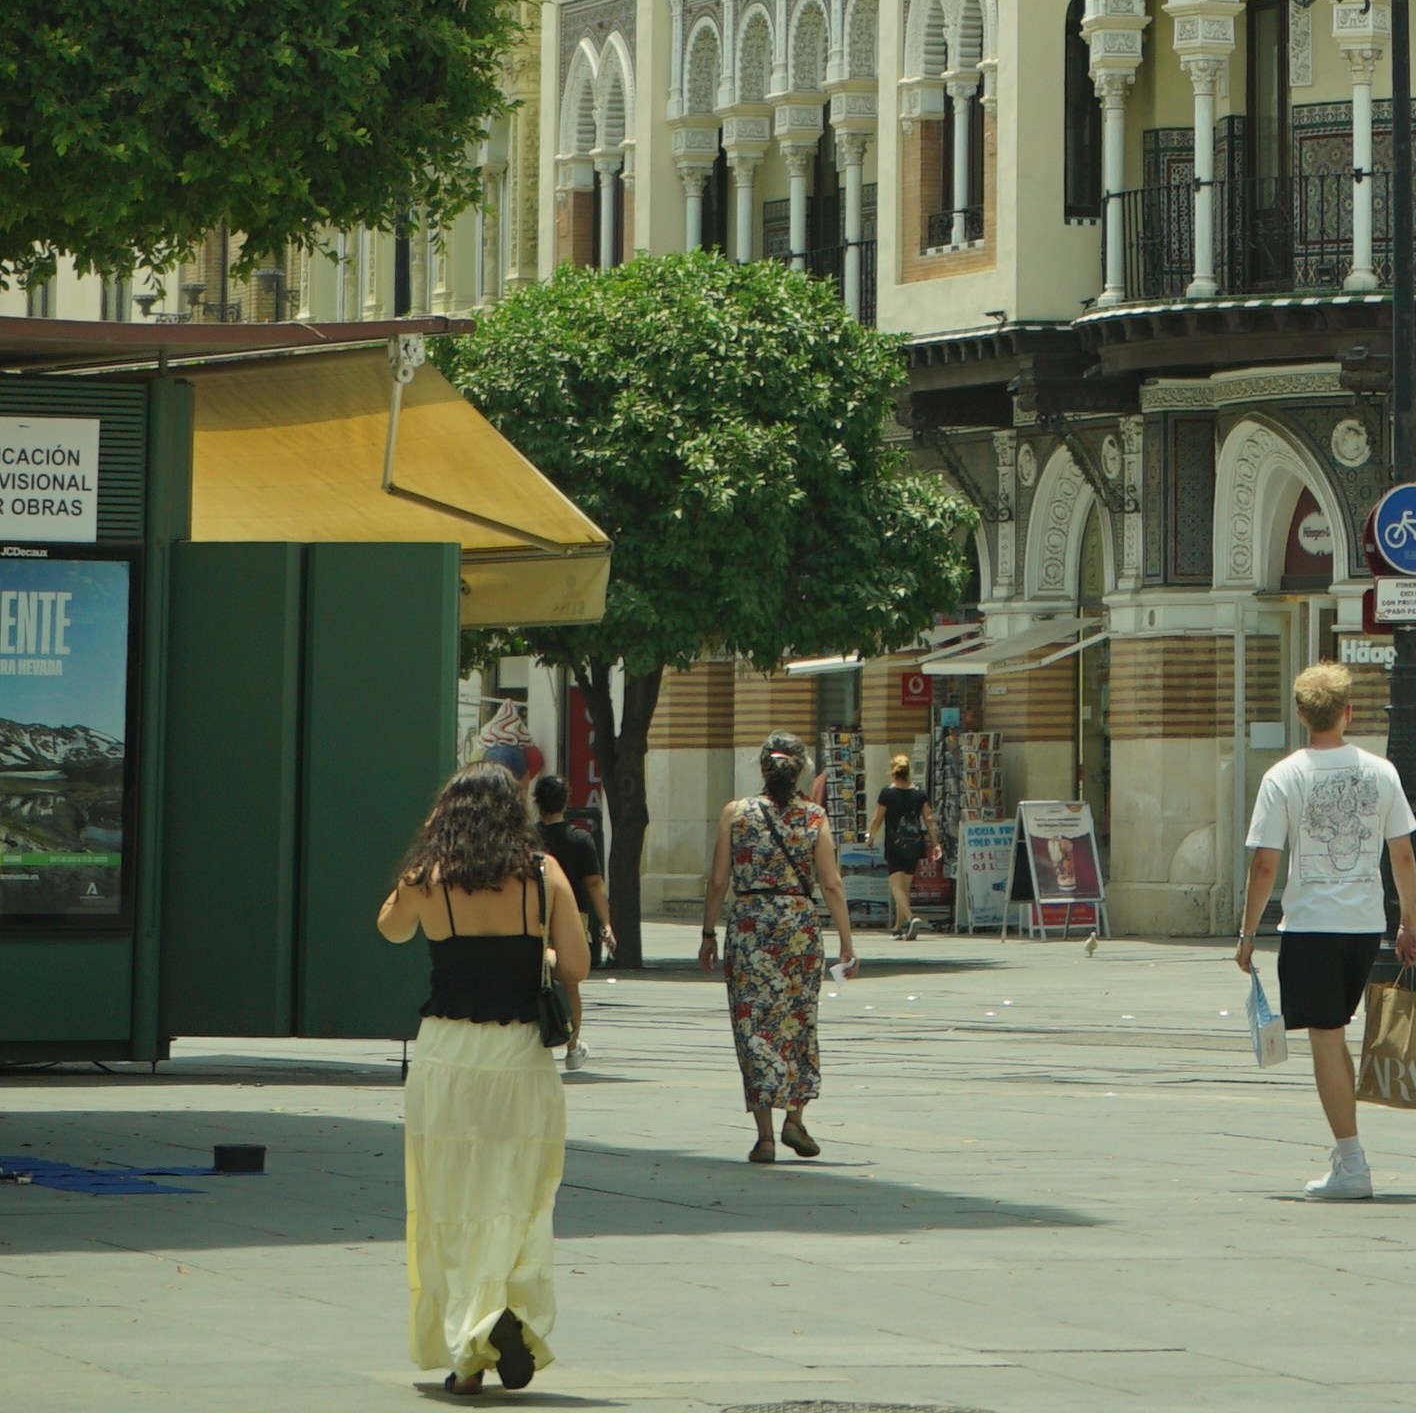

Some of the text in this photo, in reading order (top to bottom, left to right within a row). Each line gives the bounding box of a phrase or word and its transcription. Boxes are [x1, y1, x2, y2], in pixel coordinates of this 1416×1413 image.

[11, 498, 83, 516] OBRAS
[1, 547, 48, 559] JCDecaux
[0, 590, 72, 655] ENTE
[18, 659, 63, 676] NEVADA
[994, 836, 1013, 847] WAT
